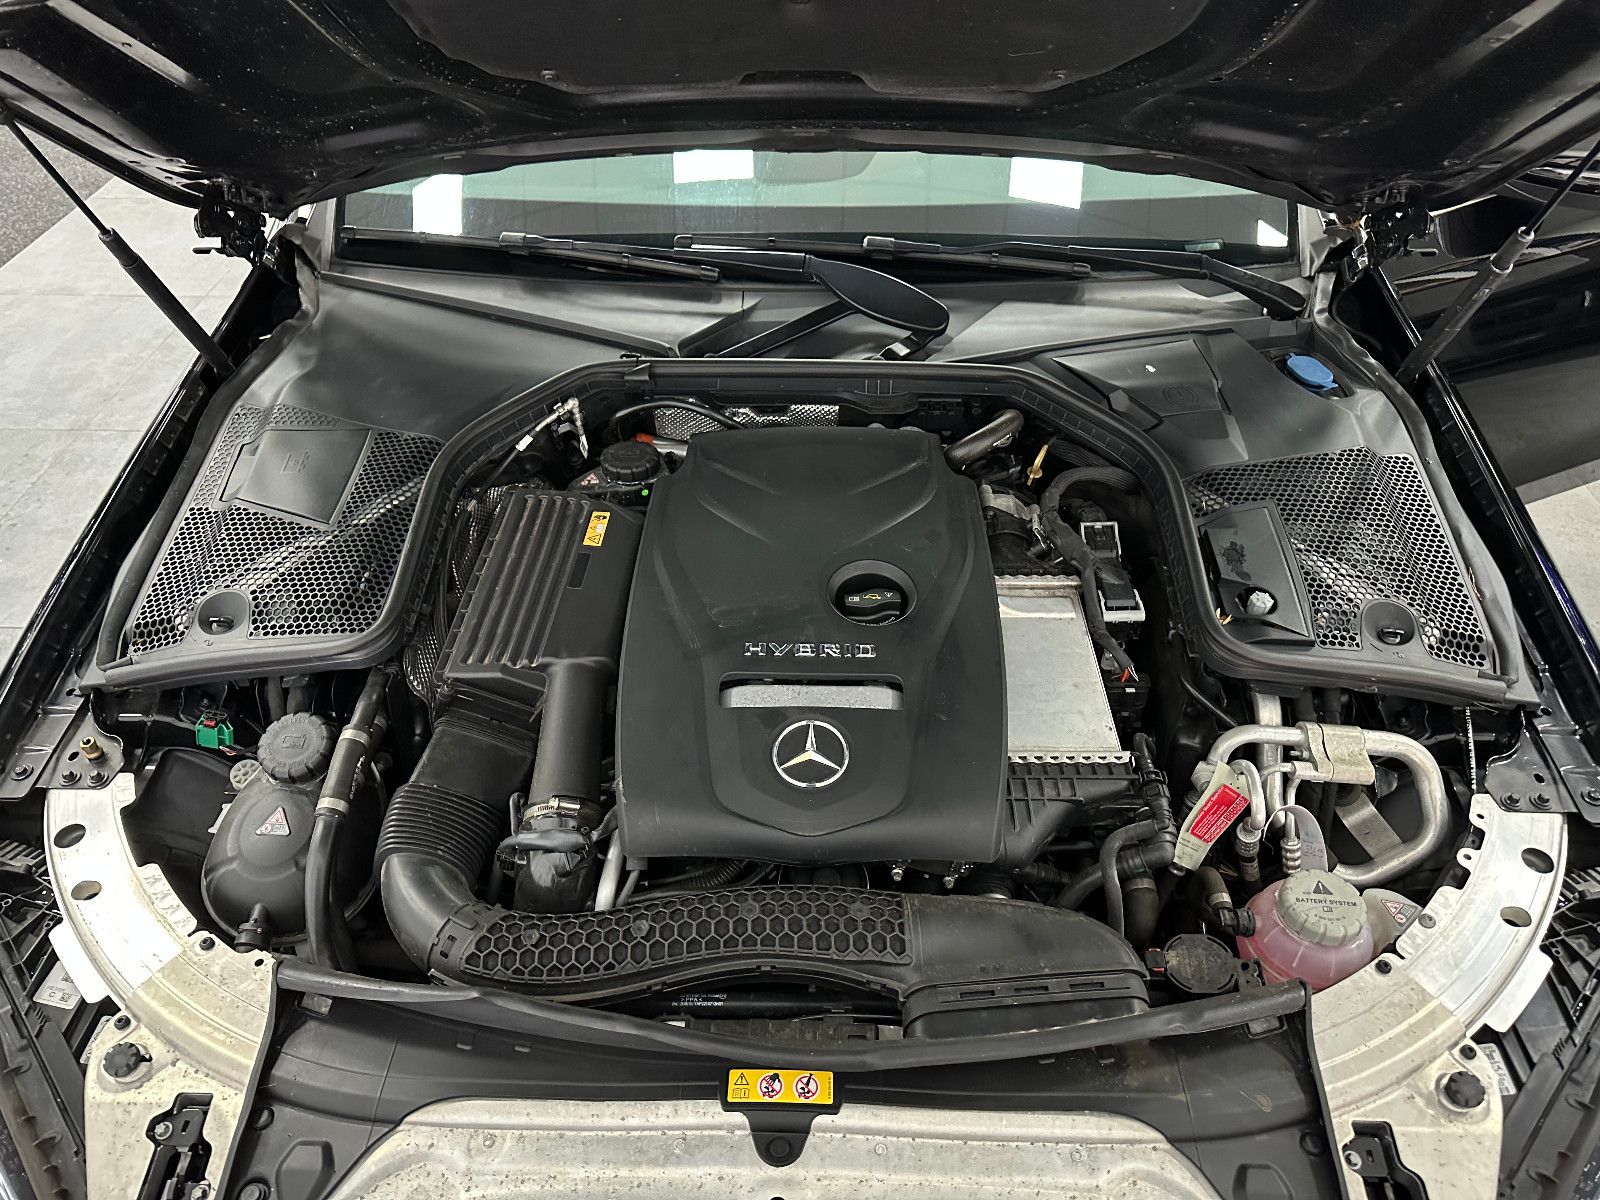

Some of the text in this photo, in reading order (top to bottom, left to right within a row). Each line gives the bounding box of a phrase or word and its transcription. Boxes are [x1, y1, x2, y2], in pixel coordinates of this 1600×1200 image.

[743, 642, 877, 658] HYBRID
[1295, 897, 1357, 907] BATTERY SYSTEM
